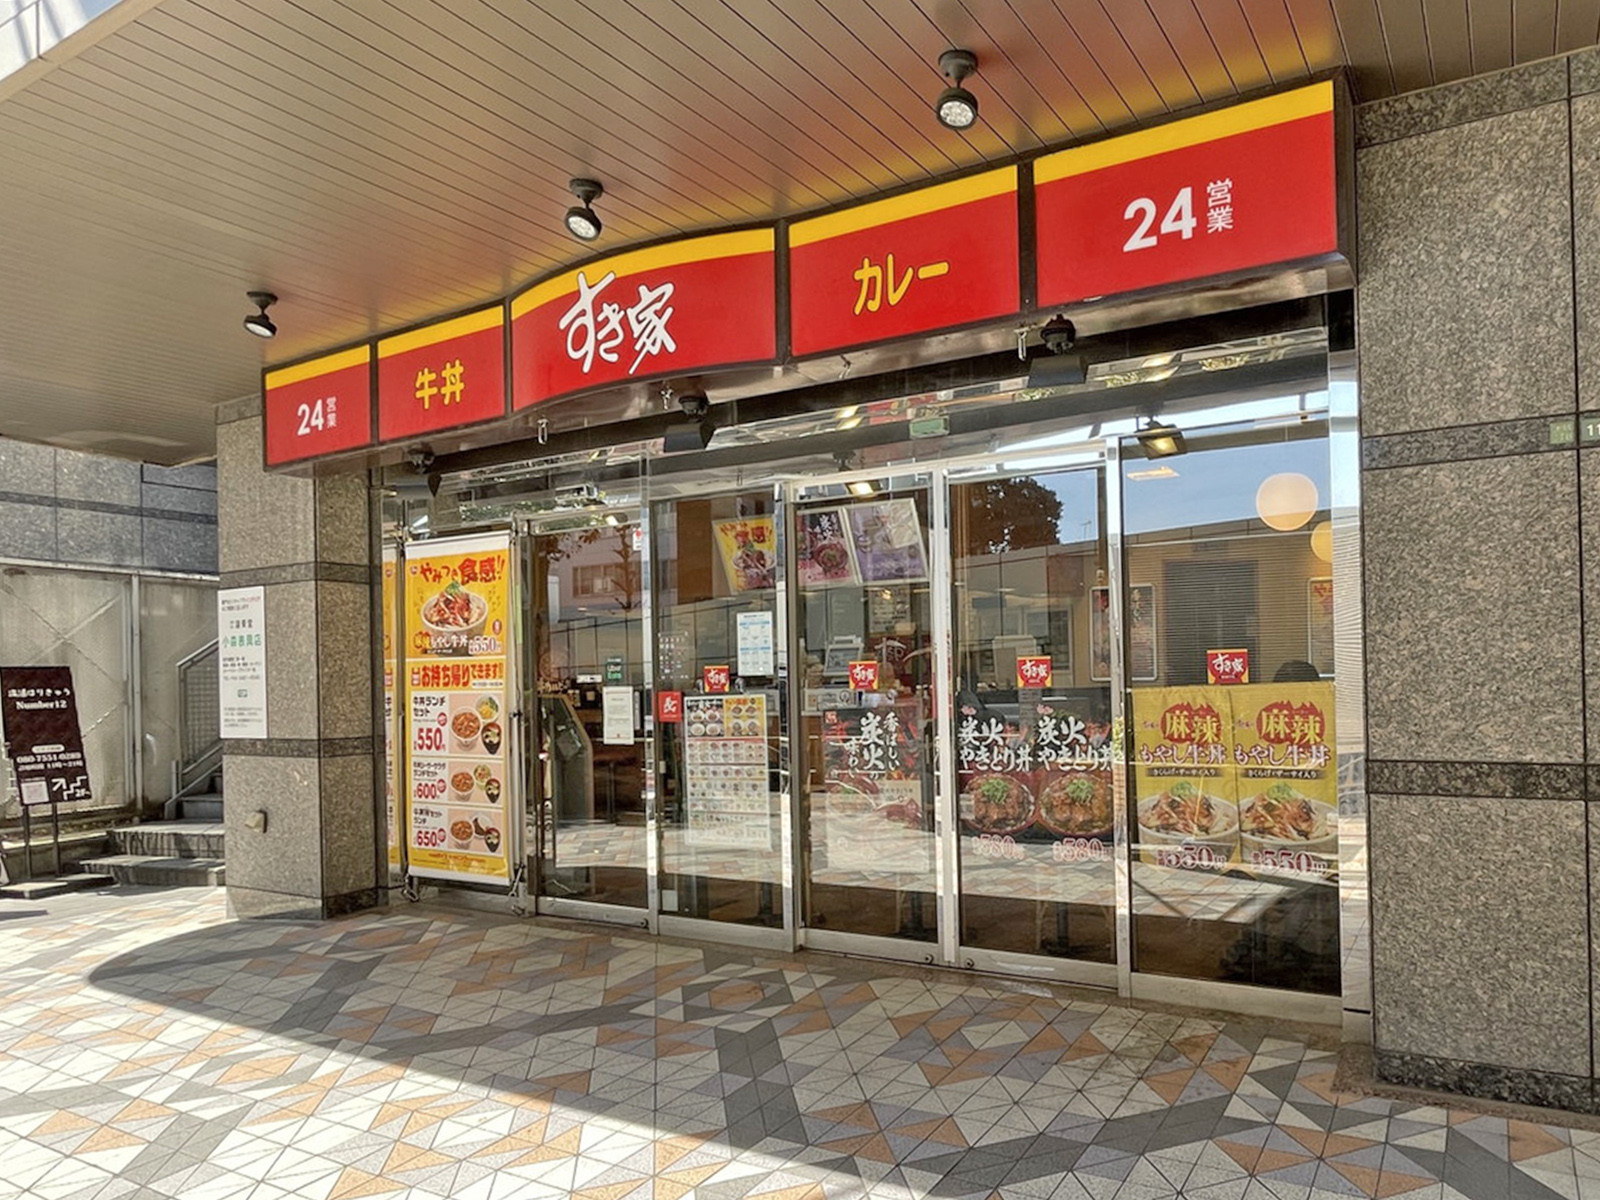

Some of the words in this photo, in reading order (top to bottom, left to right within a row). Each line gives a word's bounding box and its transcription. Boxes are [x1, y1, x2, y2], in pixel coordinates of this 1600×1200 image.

[1122, 186, 1197, 253] 24
[1205, 177, 1234, 234] 営業
[852, 252, 950, 316] カレー
[558, 270, 677, 375] すき家
[415, 359, 465, 410] 牛丼
[296, 399, 325, 436] 24
[1212, 653, 1245, 675] すき家
[417, 727, 443, 751] 550
[959, 716, 1005, 746] 炭火
[1038, 716, 1087, 746] 炭火
[1165, 709, 1223, 744] 麻辣
[1261, 708, 1323, 746] 麻辣
[960, 744, 1034, 772] やきとり丼
[1140, 744, 1227, 766] もやし牛丼
[1233, 744, 1331, 768] もやし牛丼
[417, 782, 437, 799] 600
[417, 830, 437, 847] 650
